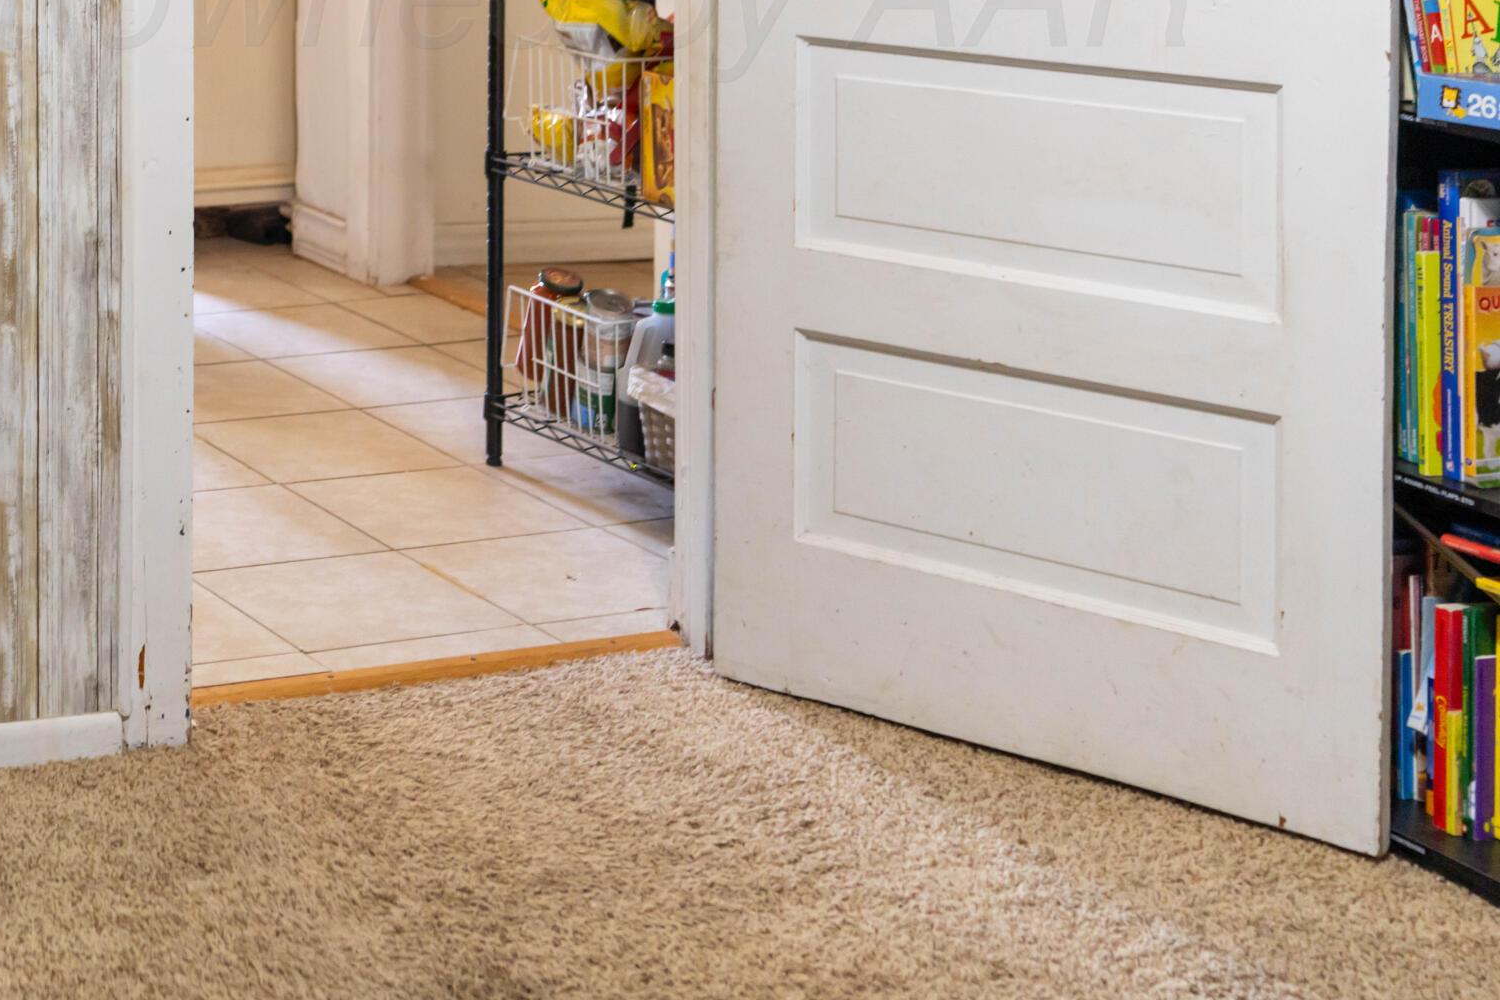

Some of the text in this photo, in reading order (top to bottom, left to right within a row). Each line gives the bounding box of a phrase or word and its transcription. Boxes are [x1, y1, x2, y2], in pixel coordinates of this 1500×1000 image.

[1442, 219, 1453, 259] Animal
[1442, 261, 1454, 301] Sound
[1442, 302, 1455, 375] TREASURY
